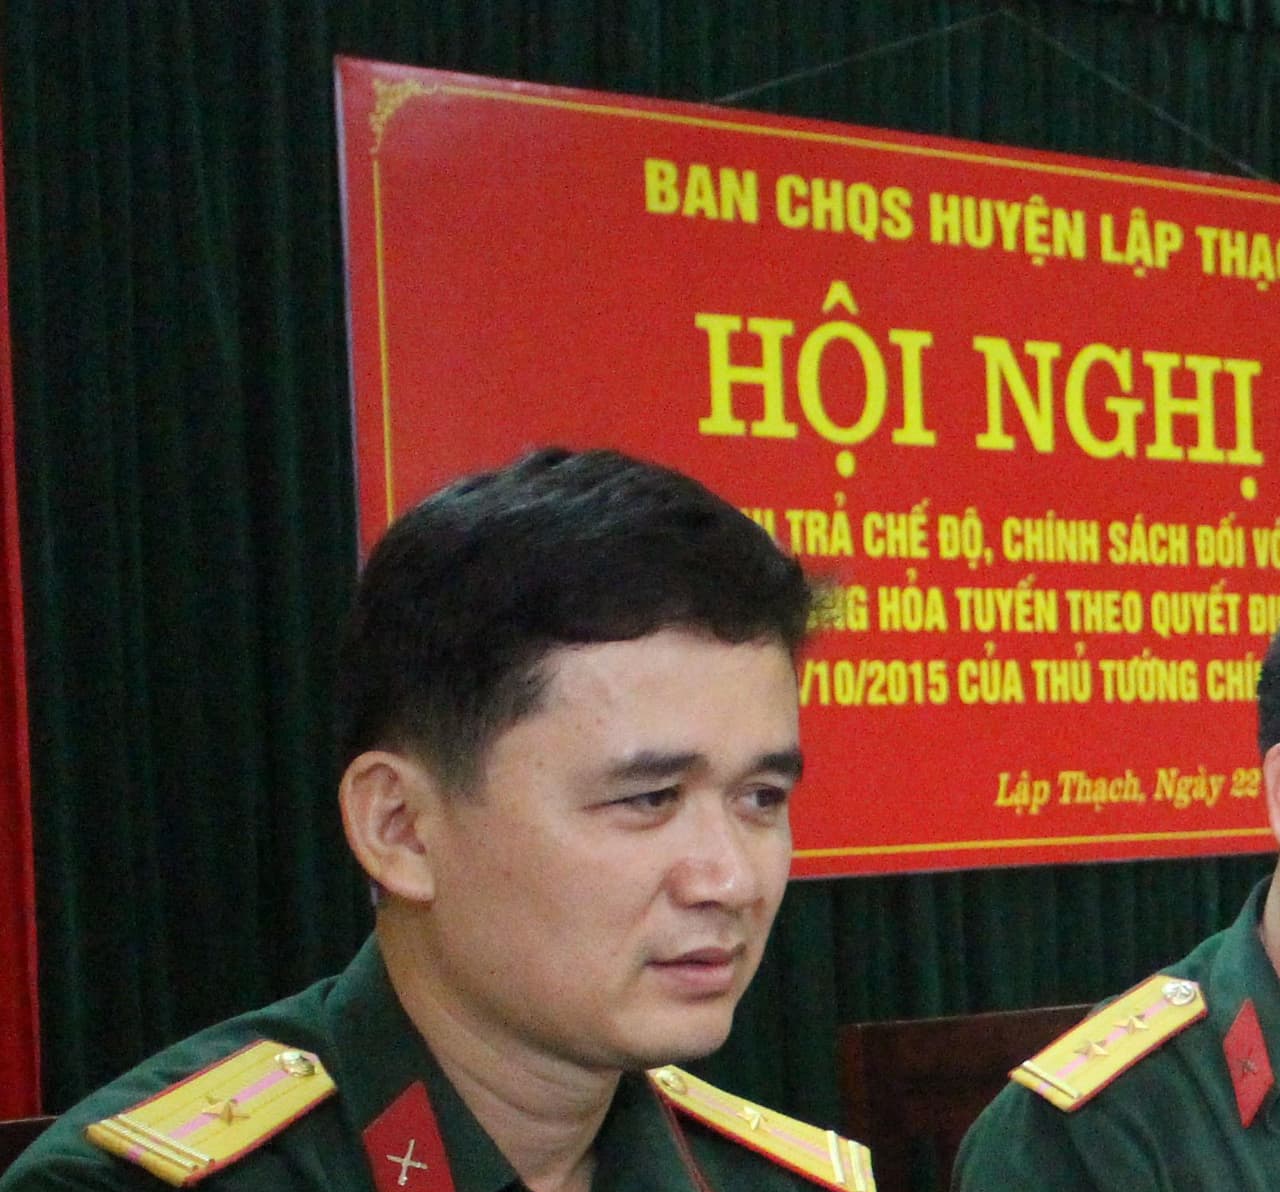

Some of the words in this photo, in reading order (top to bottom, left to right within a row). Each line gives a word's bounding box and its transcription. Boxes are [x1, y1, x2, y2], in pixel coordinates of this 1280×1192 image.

[645, 158, 758, 222] BAN
[776, 175, 913, 242] CHQS
[930, 195, 1086, 266] HUYỆN
[1100, 208, 1183, 277] LẬP
[696, 281, 933, 477] HỘI
[973, 336, 1264, 500] NGHỊ
[785, 492, 854, 556] TRẢ
[863, 499, 929, 559] CHẾ
[938, 507, 994, 569] ĐỘ,
[1002, 510, 1099, 565] CHÍNH
[1108, 514, 1188, 566] SÁCH
[1196, 512, 1246, 568] ĐỐI
[955, 574, 1058, 632] TUYẾN
[1065, 590, 1143, 634] THEO
[1151, 579, 1241, 638] QUYẾT
[958, 641, 1025, 704] CỦA
[1031, 642, 1091, 703] THỦ
[1099, 648, 1199, 703] TƯỚNG
[995, 771, 1050, 815] Lập
[1154, 766, 1225, 808] Ngày
